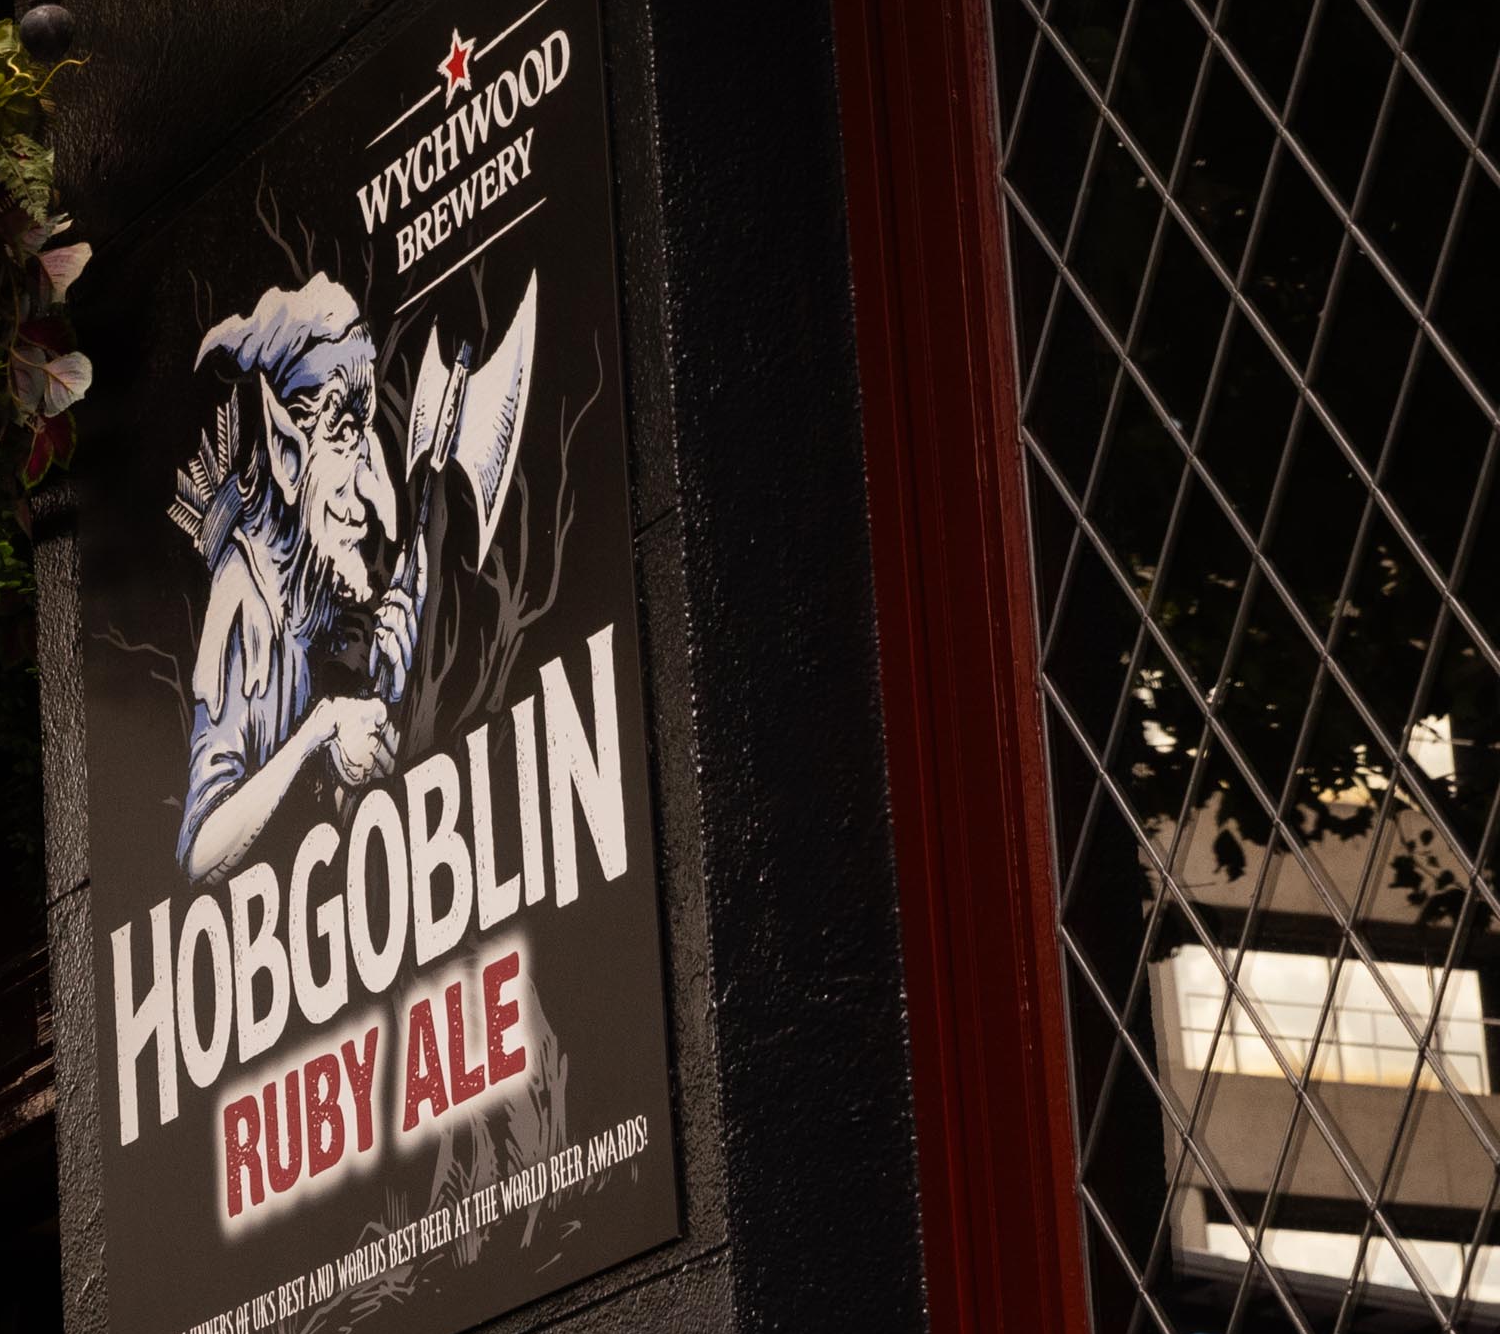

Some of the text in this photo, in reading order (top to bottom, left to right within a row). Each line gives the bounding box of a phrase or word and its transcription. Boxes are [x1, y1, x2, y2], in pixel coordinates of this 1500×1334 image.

[356, 30, 570, 235] WYCHWOOD
[395, 127, 534, 274] BREWERY
[110, 622, 627, 1146] HOBGOBLIN
[223, 951, 526, 1218] RUBY ALE
[278, 1279, 306, 1320] BEST
[308, 1265, 334, 1307] AND
[336, 1238, 386, 1295] WORLDS
[388, 1224, 418, 1268] BEST
[420, 1210, 452, 1255] BEER
[453, 1197, 470, 1240] AT
[470, 1183, 499, 1230] THE
[499, 1161, 549, 1218] WORLD
[550, 1140, 583, 1194] BEER
[586, 1116, 649, 1178] AWARDS!
